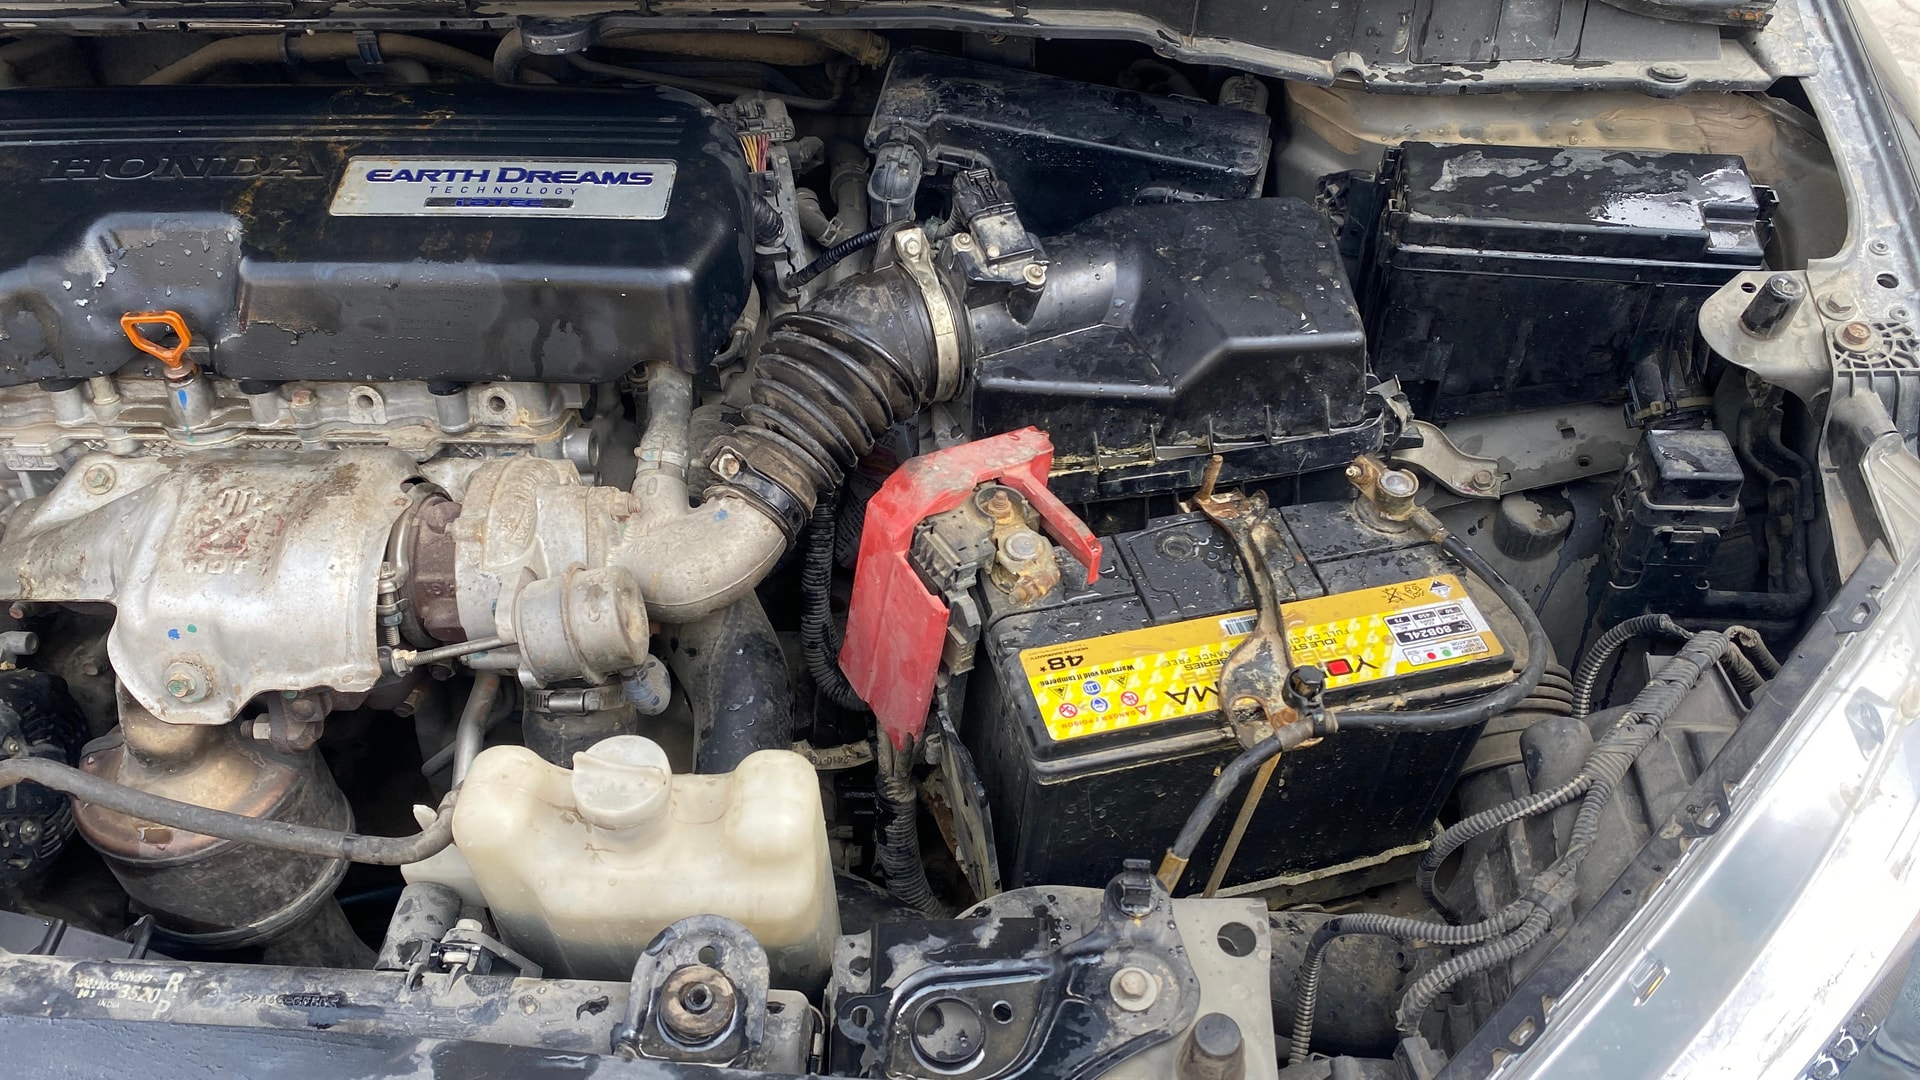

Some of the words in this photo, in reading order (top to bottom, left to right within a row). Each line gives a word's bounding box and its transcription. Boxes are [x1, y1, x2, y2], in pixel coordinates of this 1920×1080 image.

[41, 158, 323, 181] HONDA
[365, 168, 491, 183] EARTH
[495, 167, 653, 186] DREAMS
[430, 186, 578, 196] TECHNOLOGY
[1289, 633, 1320, 643] CALCI
[1322, 628, 1349, 638] FULL
[1404, 625, 1452, 641] 80B24L
[1292, 643, 1307, 652] ST
[1310, 638, 1337, 648] IDLE
[1165, 657, 1191, 668] FREE
[1083, 670, 1099, 680] void
[1099, 664, 1135, 677] Warranty
[1102, 710, 1136, 721] DANGER
[1061, 718, 1094, 729] POISON
[97, 999, 120, 1008] INDIA
